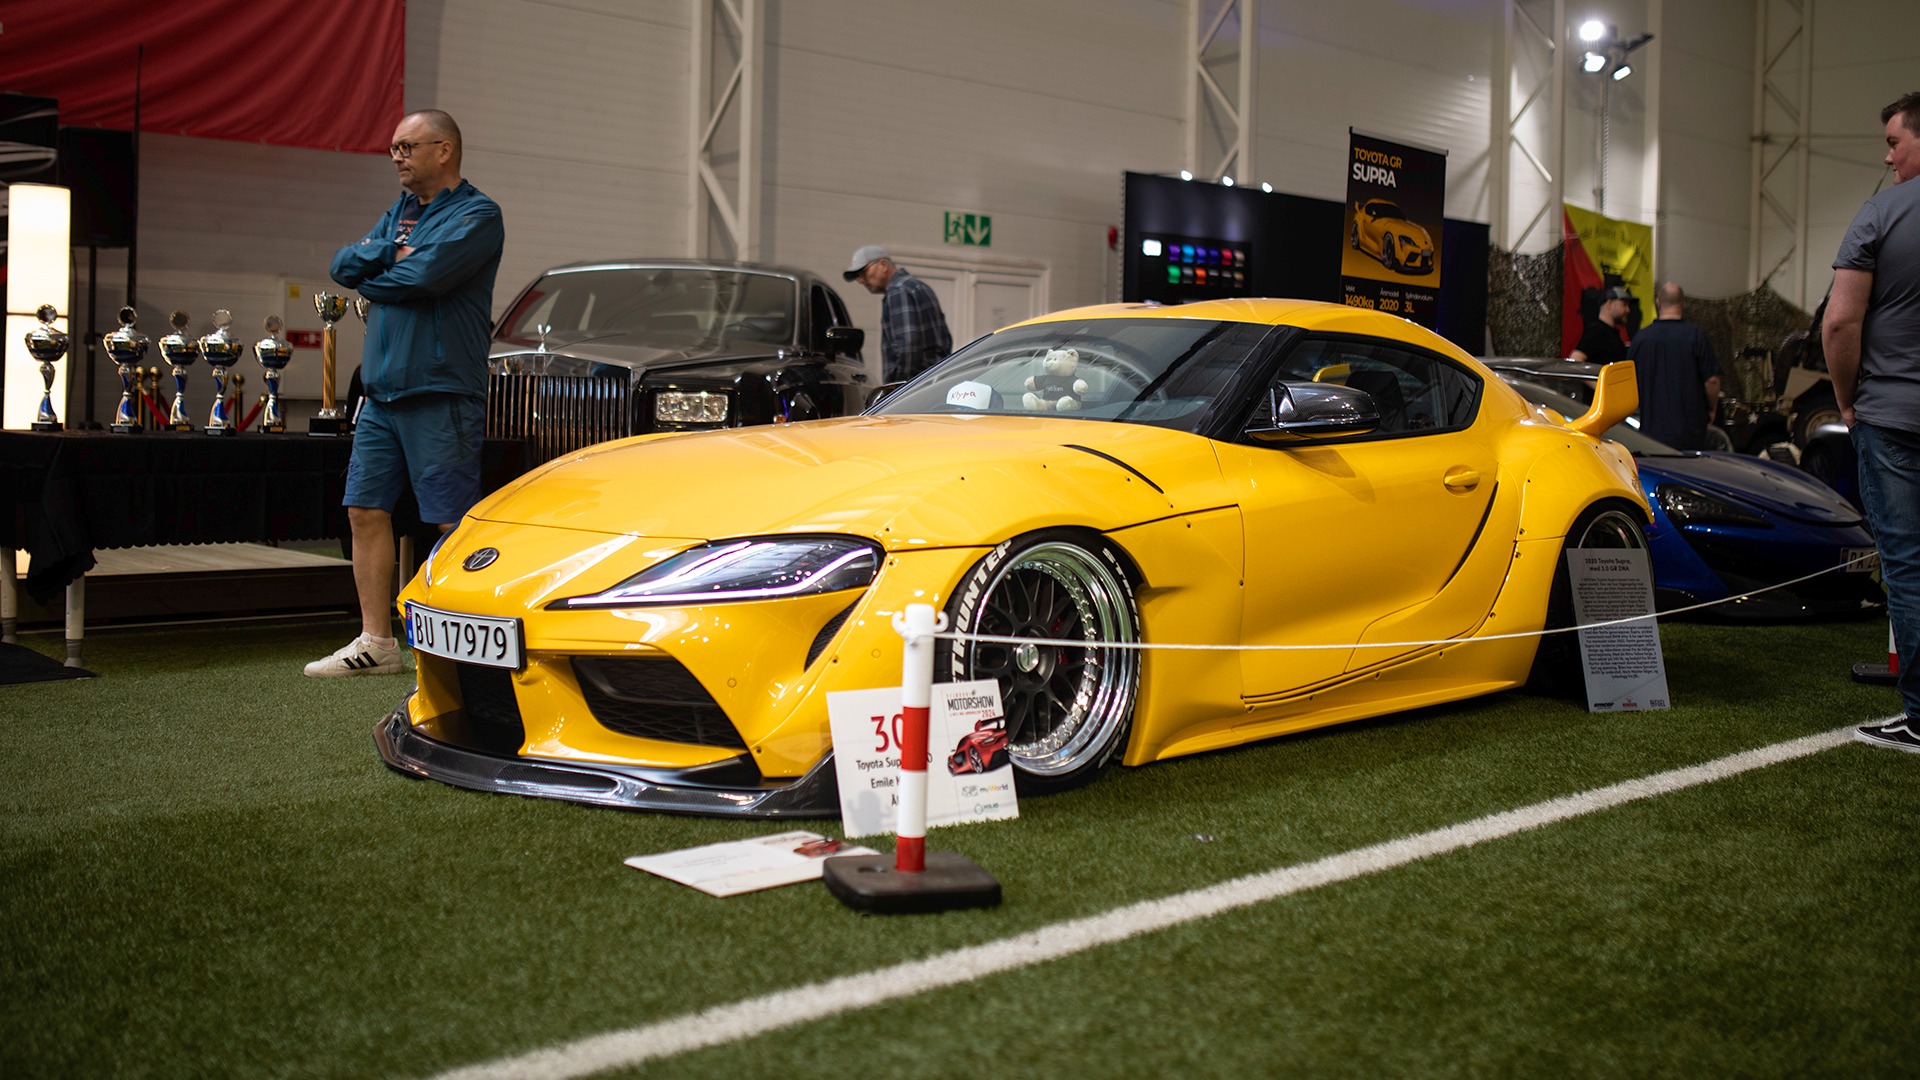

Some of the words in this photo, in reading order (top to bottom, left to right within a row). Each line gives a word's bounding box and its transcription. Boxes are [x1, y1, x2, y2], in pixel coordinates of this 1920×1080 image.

[1354, 147, 1389, 166] TOYOTA
[1390, 156, 1403, 170] GR
[1353, 162, 1397, 188] SUPRA
[1345, 294, 1374, 310] 1490kg
[1379, 298, 1399, 311] 2020
[1405, 301, 1414, 313] 3L
[1598, 558, 1615, 566] Toyota
[415, 612, 434, 648] BU
[441, 620, 507, 660] 17979
[947, 696, 994, 711] MOTORSHOW
[856, 759, 884, 772] Toyota
[870, 777, 894, 789] Emile
